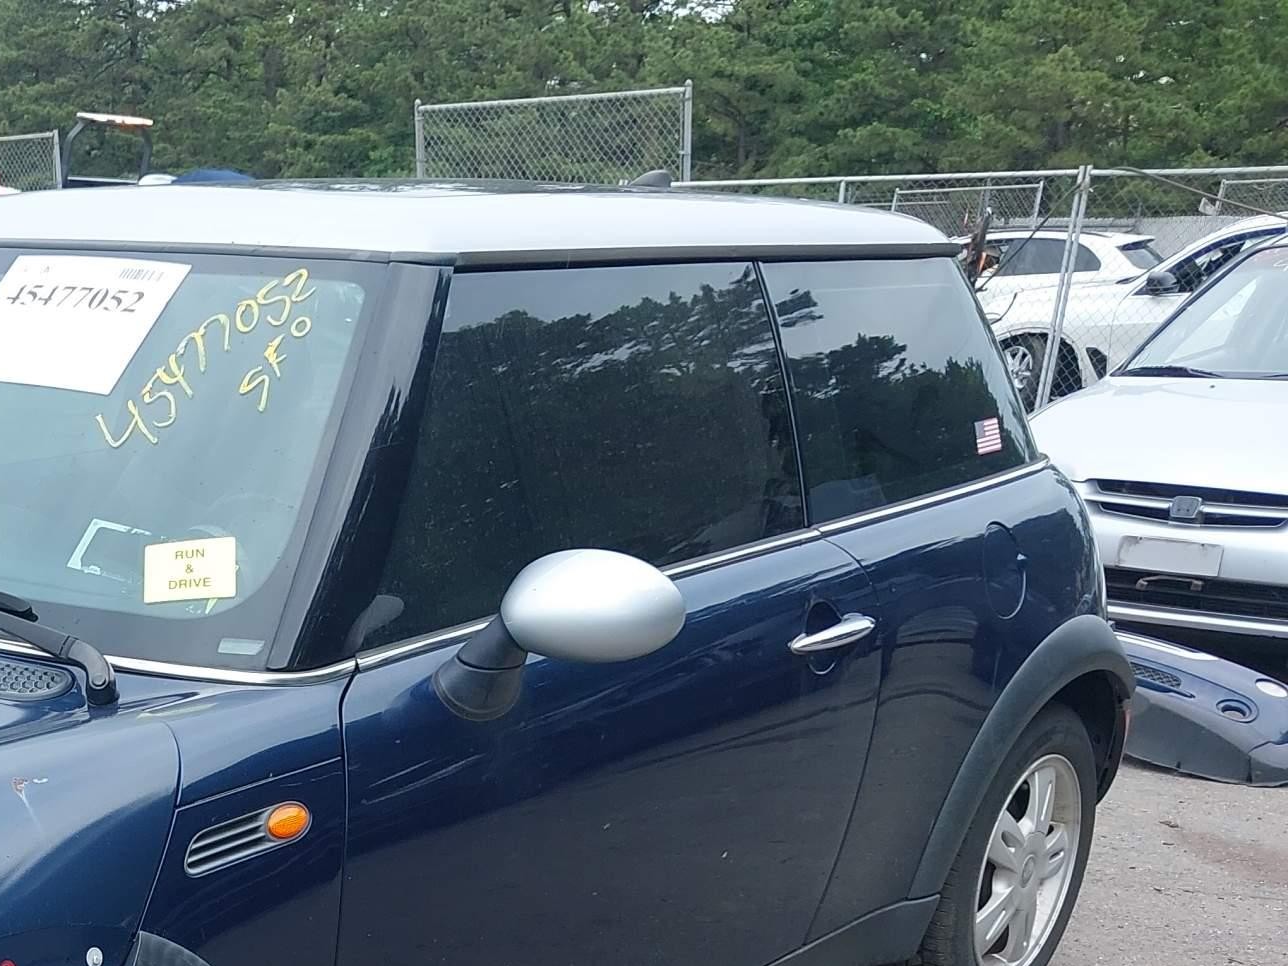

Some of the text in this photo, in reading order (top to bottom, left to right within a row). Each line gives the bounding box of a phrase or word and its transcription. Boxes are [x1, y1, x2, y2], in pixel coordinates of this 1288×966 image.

[6, 284, 145, 313] 45477052
[94, 268, 316, 448] 45477052
[174, 548, 205, 560] RUN
[185, 563, 194, 574] &
[168, 577, 212, 590] DRIVE
